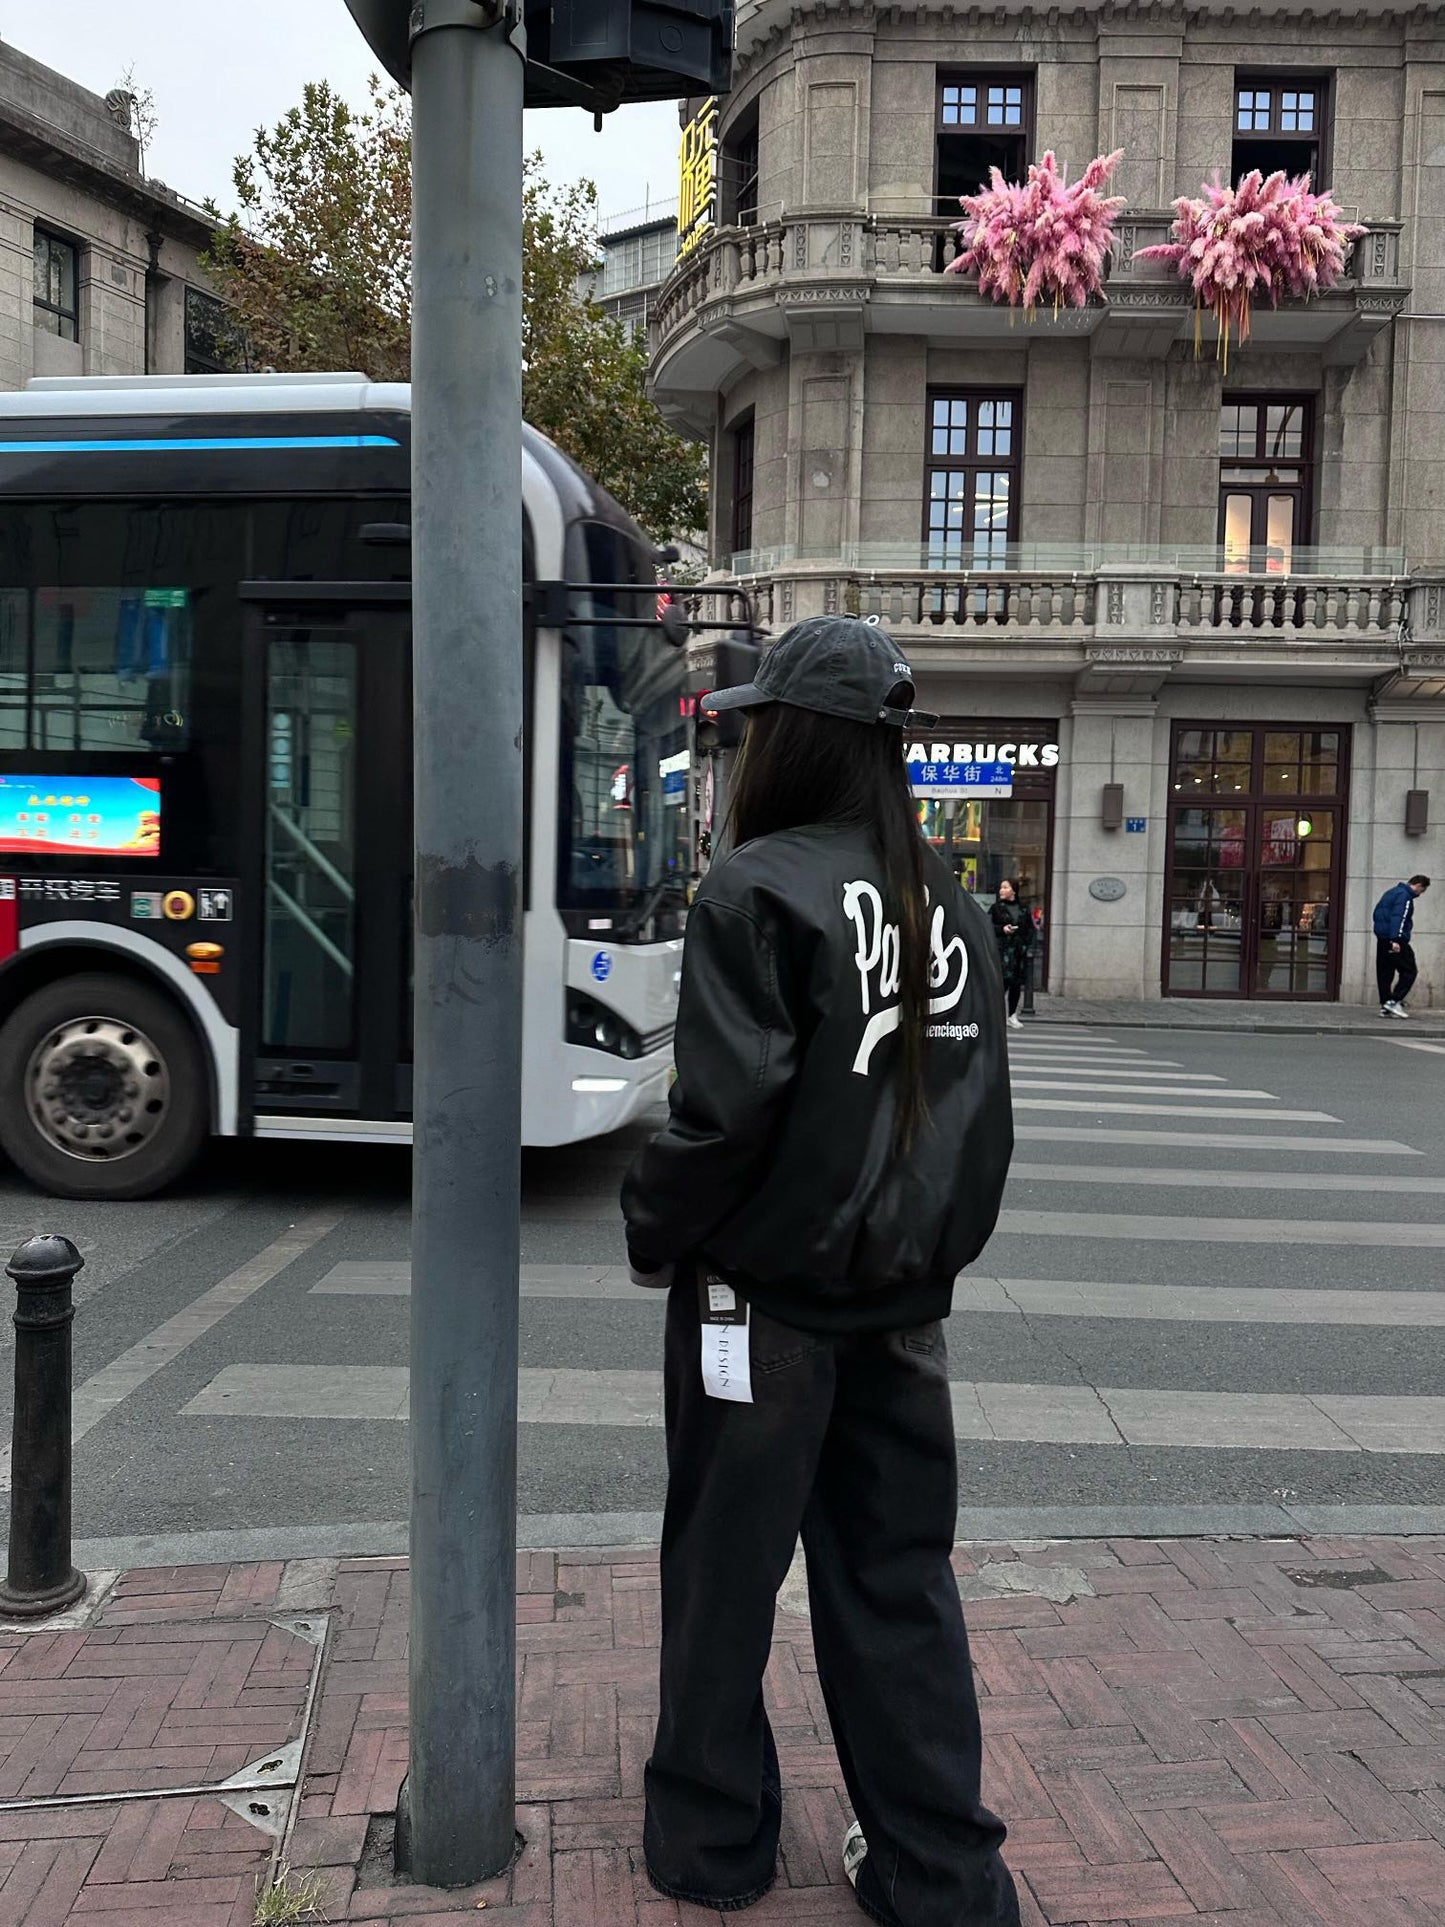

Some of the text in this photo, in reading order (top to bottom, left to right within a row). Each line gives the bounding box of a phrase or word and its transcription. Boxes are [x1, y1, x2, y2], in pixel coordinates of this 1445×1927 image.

[903, 743, 1060, 766] ARBUCKS
[921, 765, 982, 783] 保华街
[995, 766, 1004, 774] 北
[843, 880, 969, 1076] Pas
